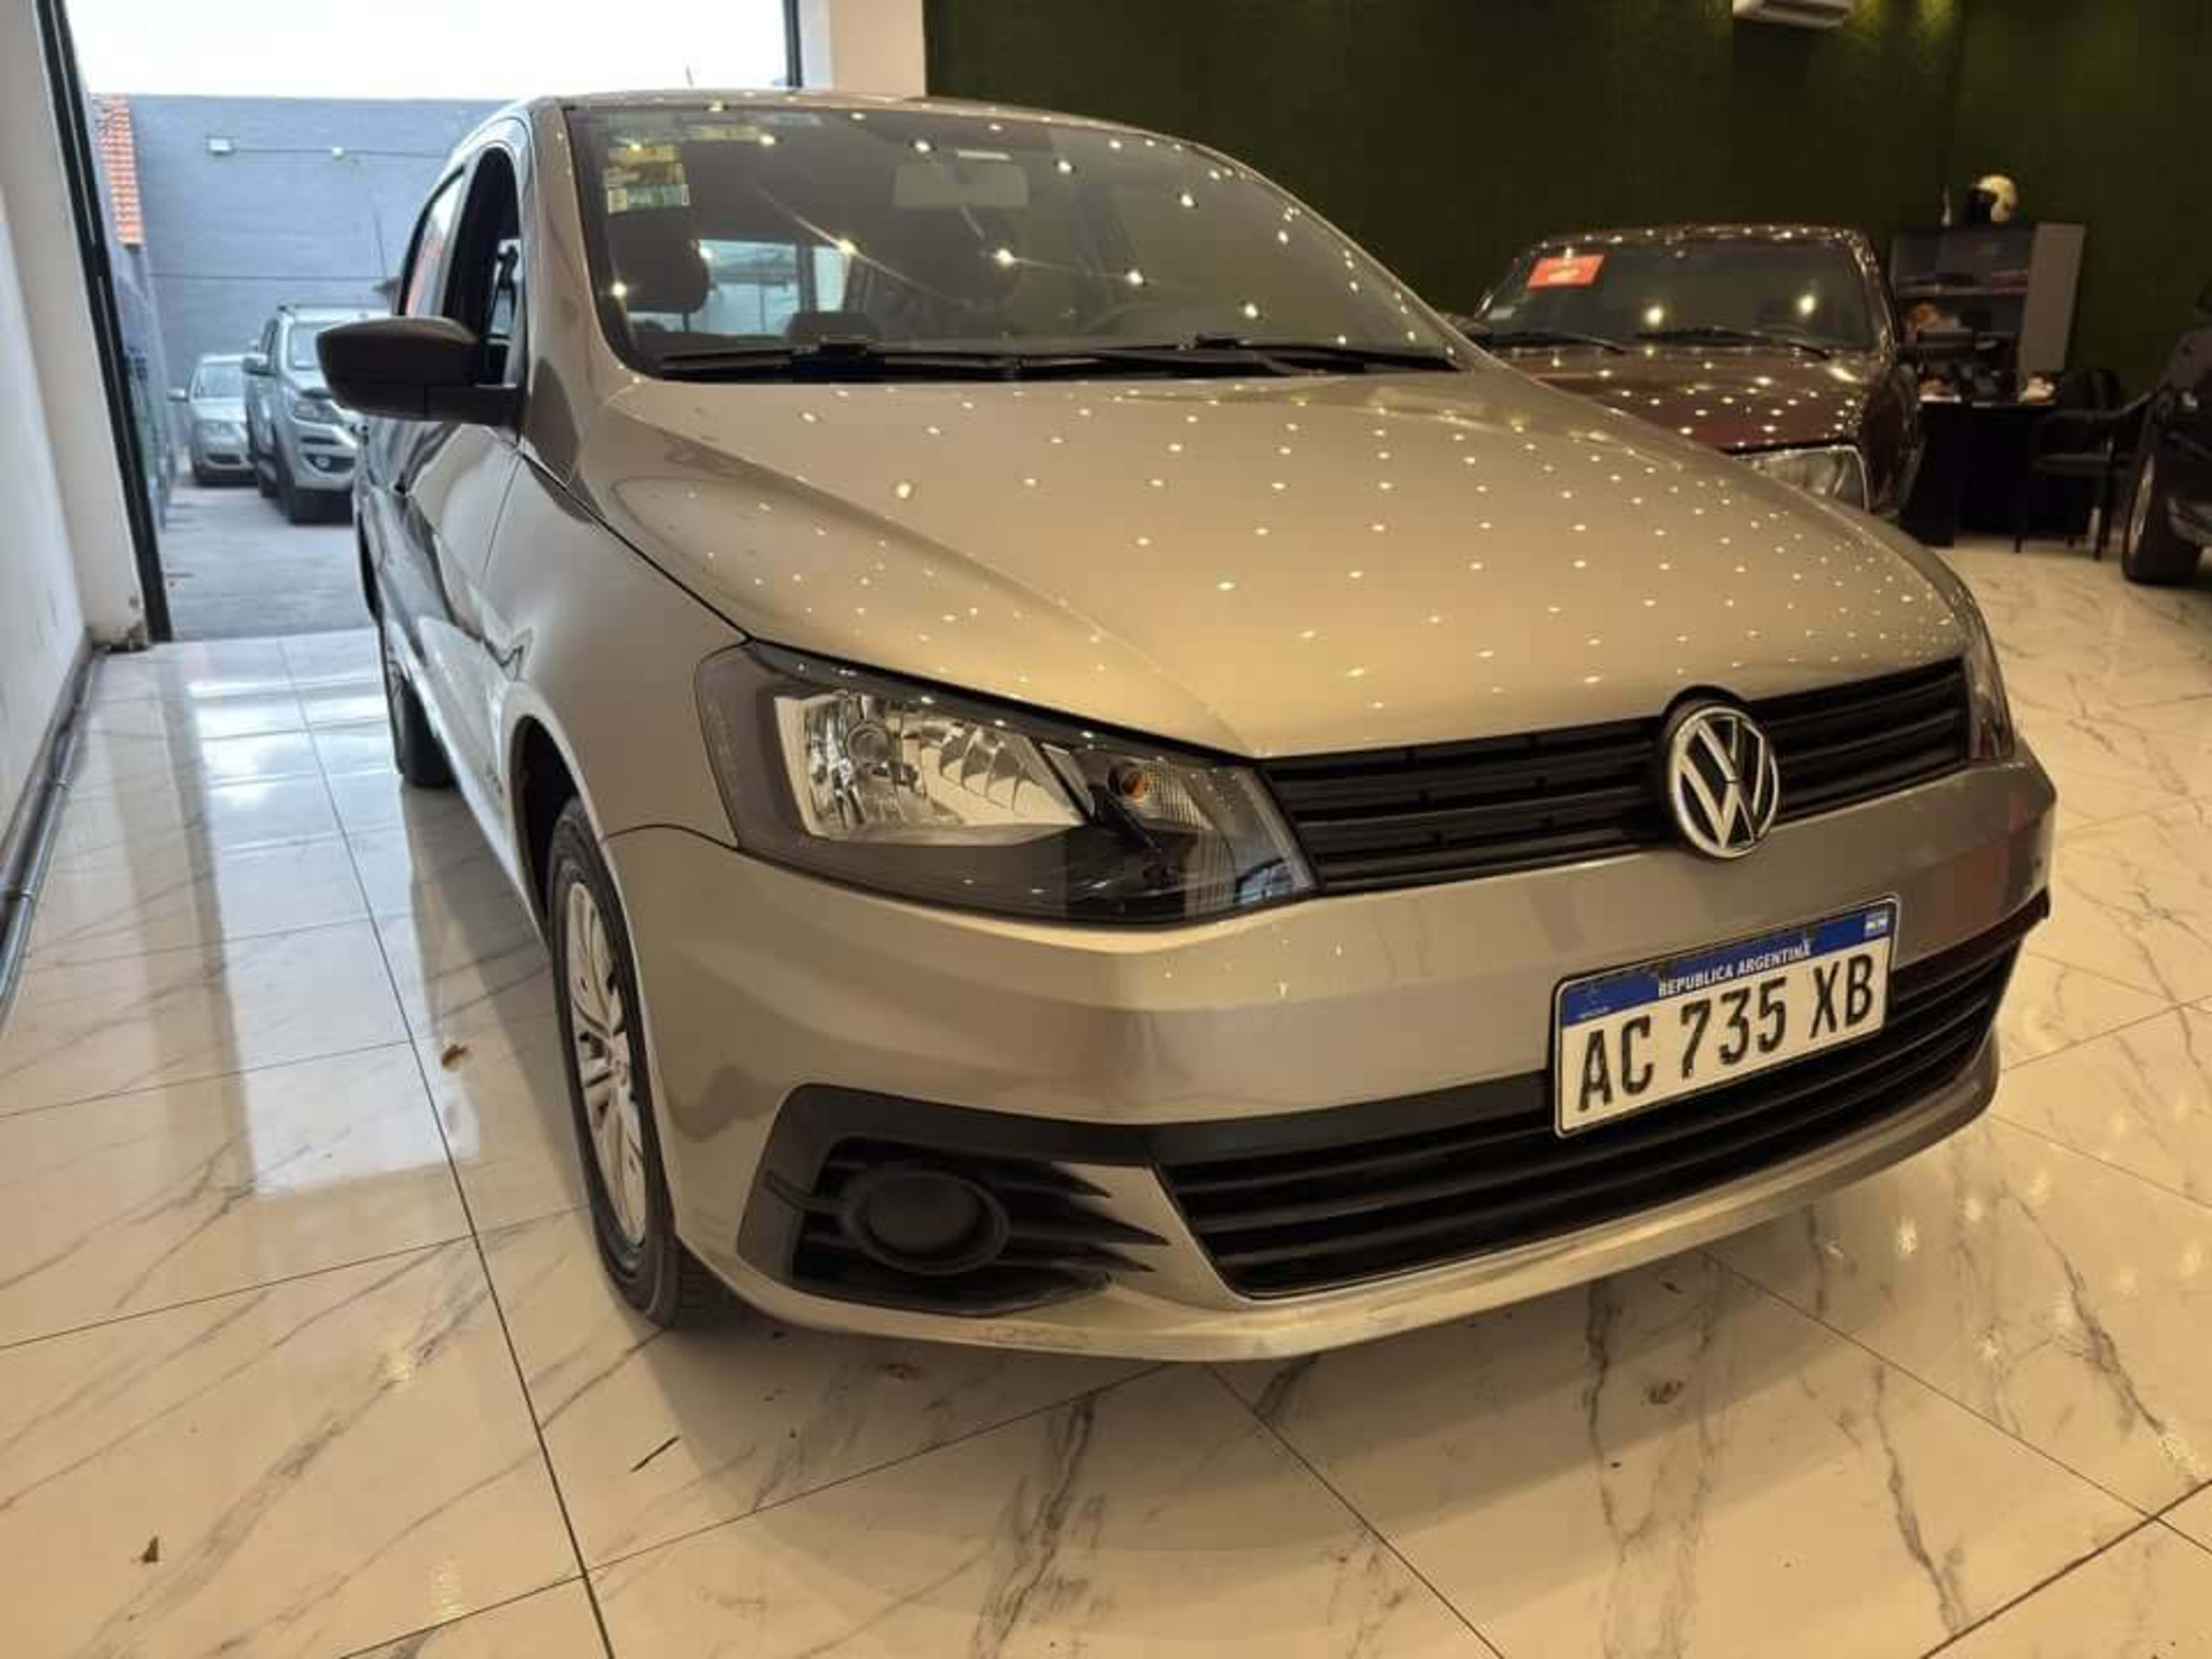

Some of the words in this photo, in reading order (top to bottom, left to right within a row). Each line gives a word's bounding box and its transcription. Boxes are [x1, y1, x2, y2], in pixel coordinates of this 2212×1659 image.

[1658, 963, 1734, 997] REPUBLICA
[1737, 939, 1811, 976] ARGENTINA
[1577, 1016, 1654, 1112] AC
[1680, 978, 1788, 1079] 735
[1809, 953, 1873, 1039] XB
